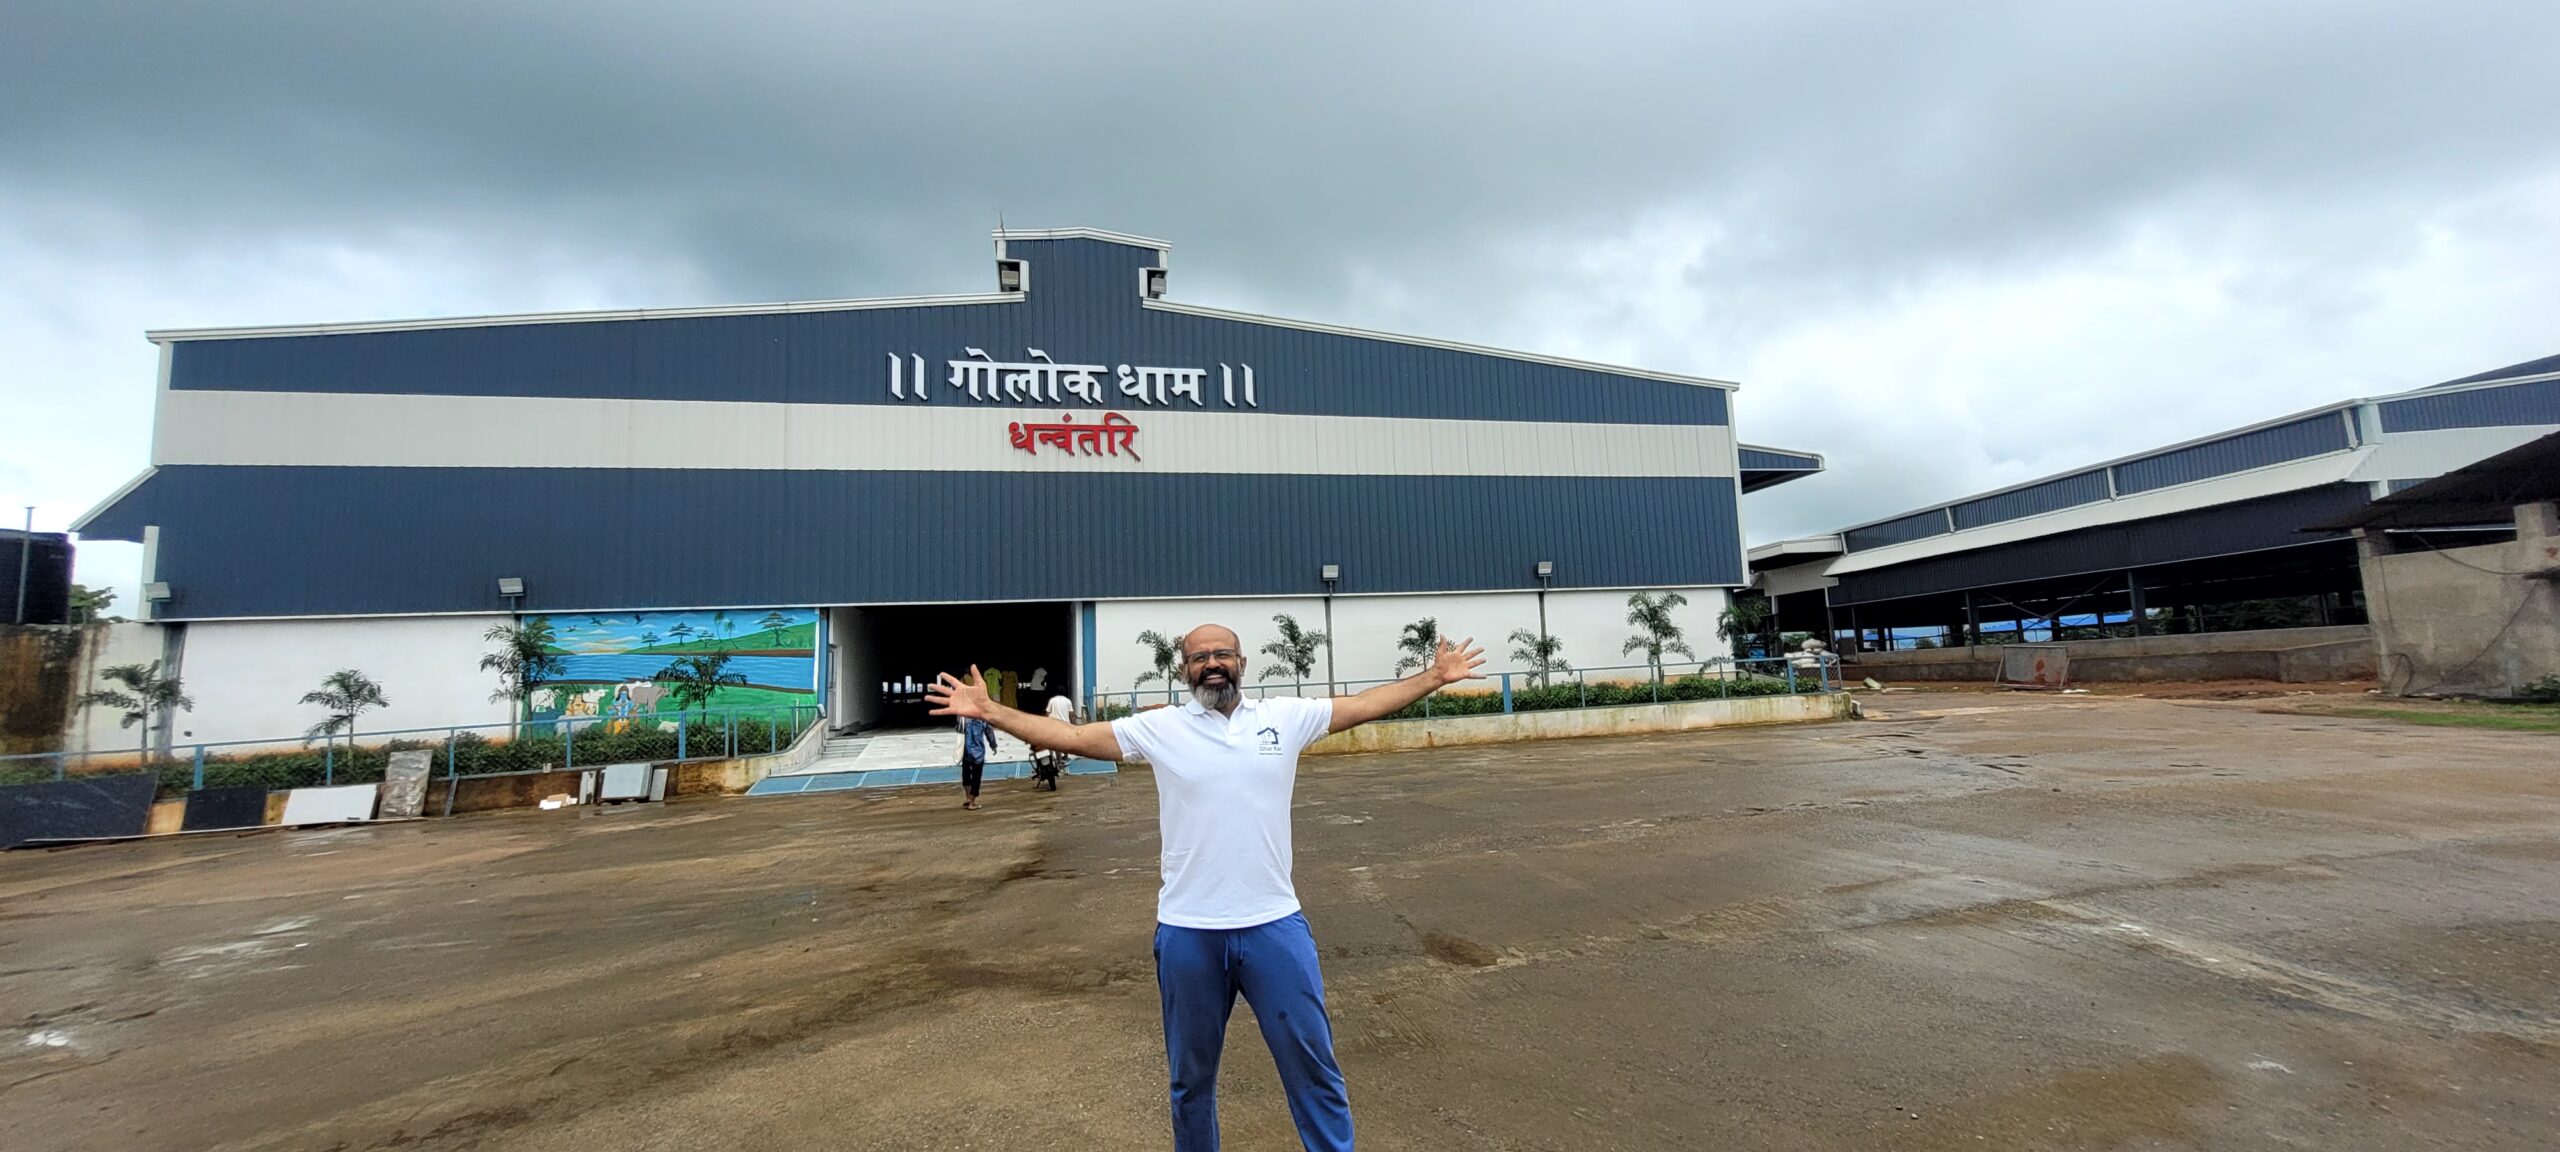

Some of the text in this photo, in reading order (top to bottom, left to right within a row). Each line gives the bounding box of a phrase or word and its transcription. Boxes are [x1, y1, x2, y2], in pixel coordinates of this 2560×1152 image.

[947, 346, 1108, 402] गोलोक
[1117, 363, 1207, 405] धाम
[1008, 412, 1141, 461] धन्वंतरि
